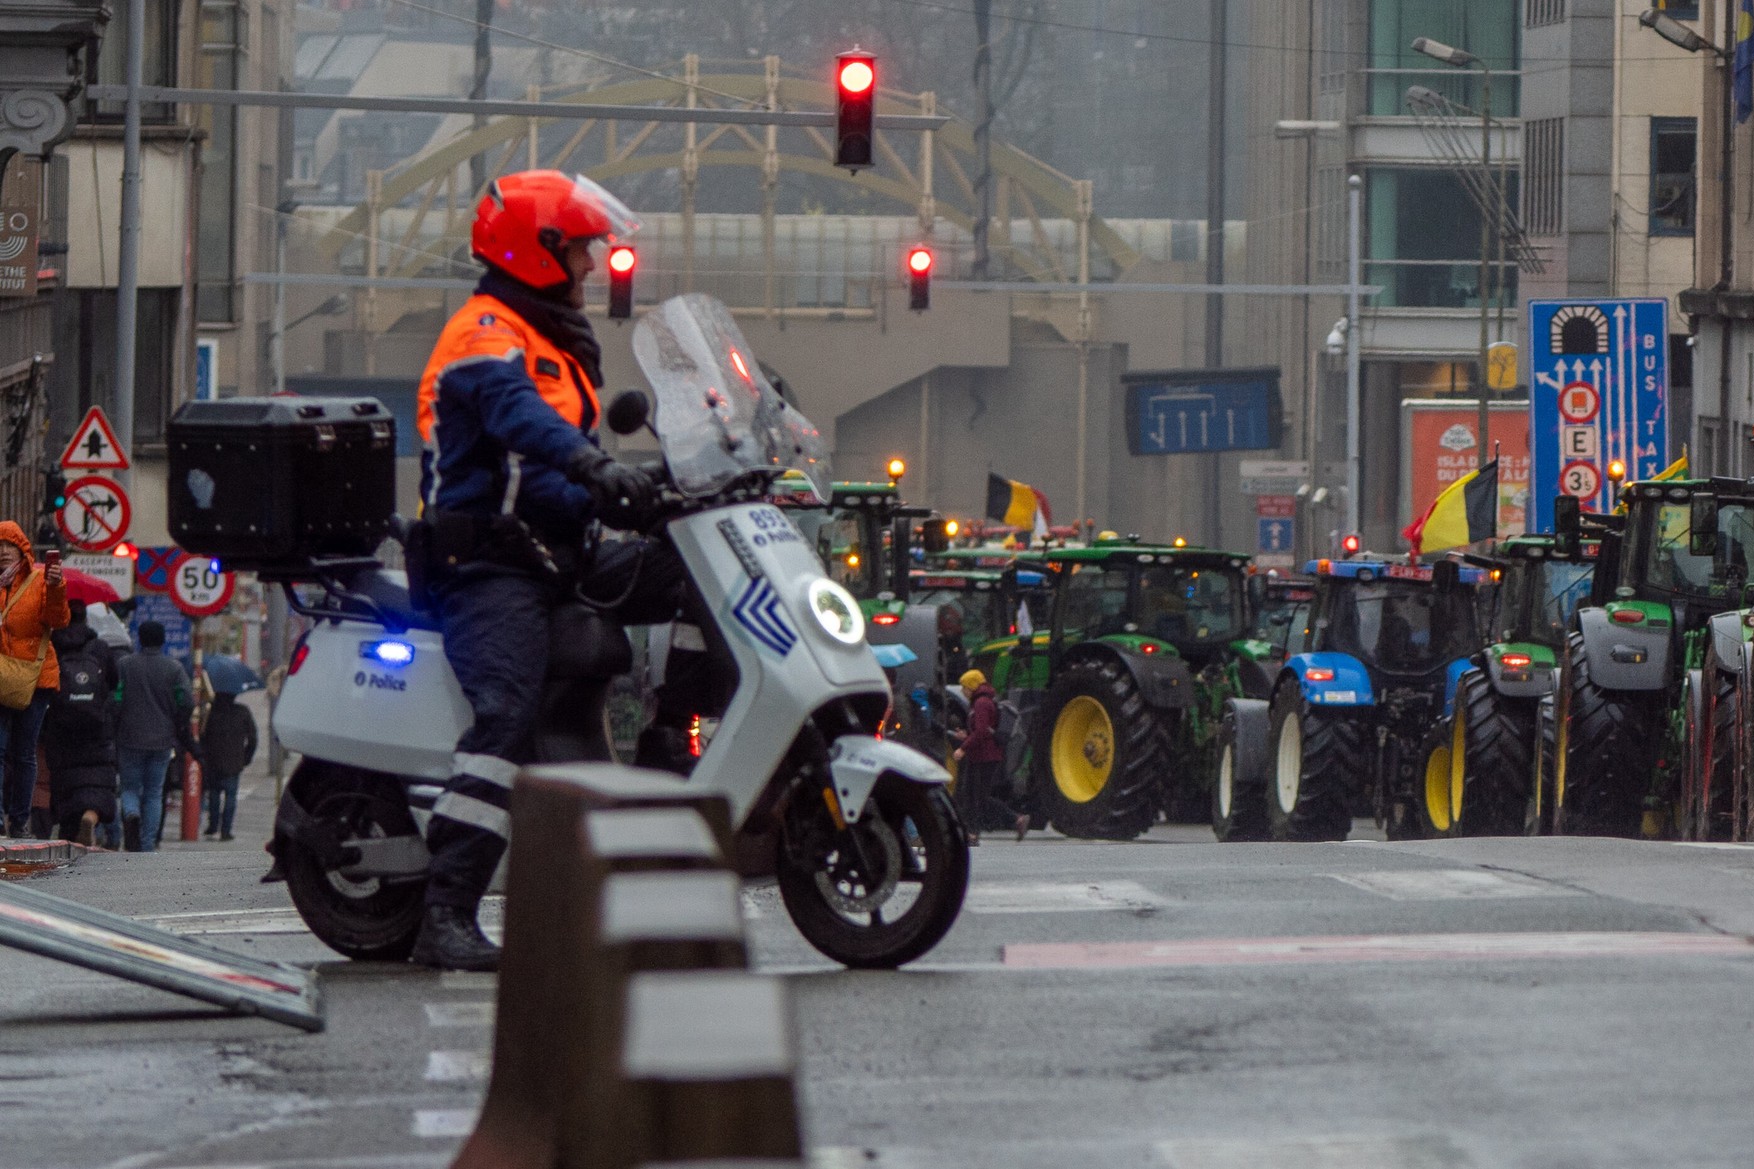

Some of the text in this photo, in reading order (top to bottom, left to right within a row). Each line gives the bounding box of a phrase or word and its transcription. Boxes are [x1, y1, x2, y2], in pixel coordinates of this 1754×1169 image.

[1643, 334, 1656, 392] BUS
[1573, 431, 1587, 453] E
[1645, 420, 1658, 477] TAX
[184, 566, 218, 589] 50
[369, 673, 407, 691] Police
